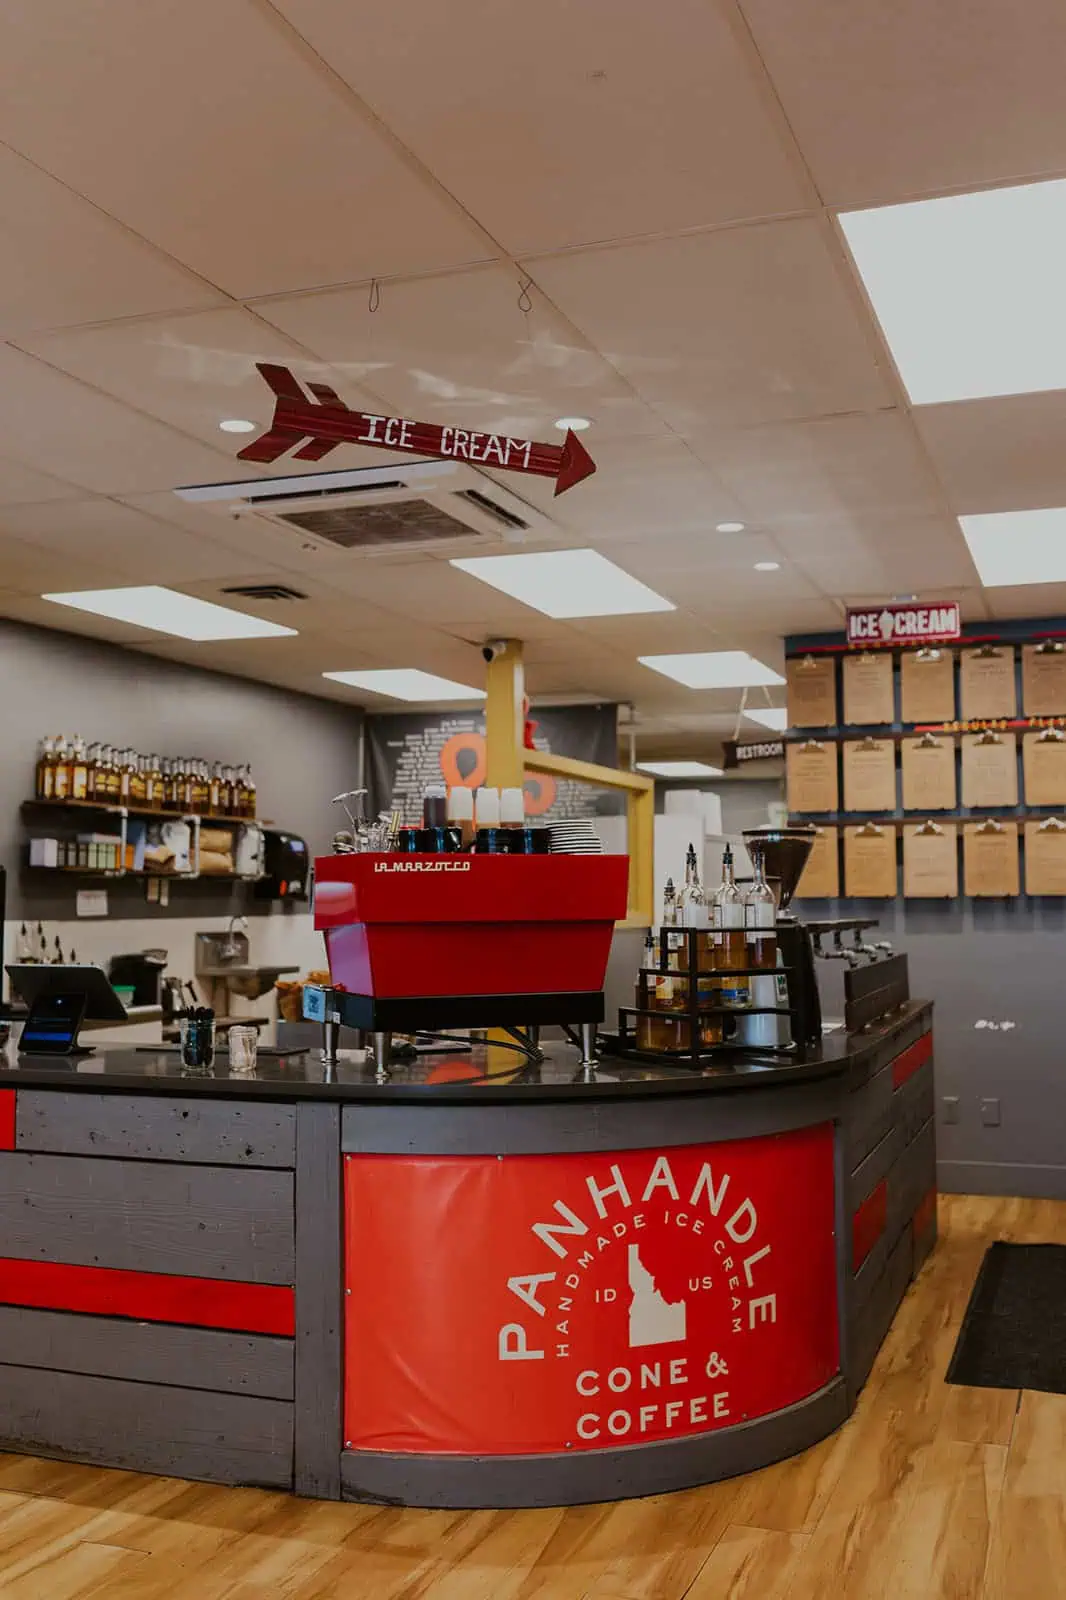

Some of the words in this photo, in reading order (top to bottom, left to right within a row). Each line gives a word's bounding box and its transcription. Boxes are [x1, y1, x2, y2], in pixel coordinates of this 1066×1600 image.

[358, 414, 417, 448] ICE
[440, 427, 532, 468] CREAM
[850, 613, 881, 638] ICE
[894, 608, 957, 635] CREAM
[498, 1156, 777, 1361] PANHANDLE
[556, 1214, 647, 1358] HANDMADE
[664, 1210, 705, 1235] ICE
[713, 1239, 742, 1333] CREAM
[595, 1288, 617, 1303] ID
[688, 1276, 713, 1292] US
[575, 1358, 688, 1396] CONE
[705, 1351, 729, 1378] &
[576, 1391, 730, 1439] COFFEE
